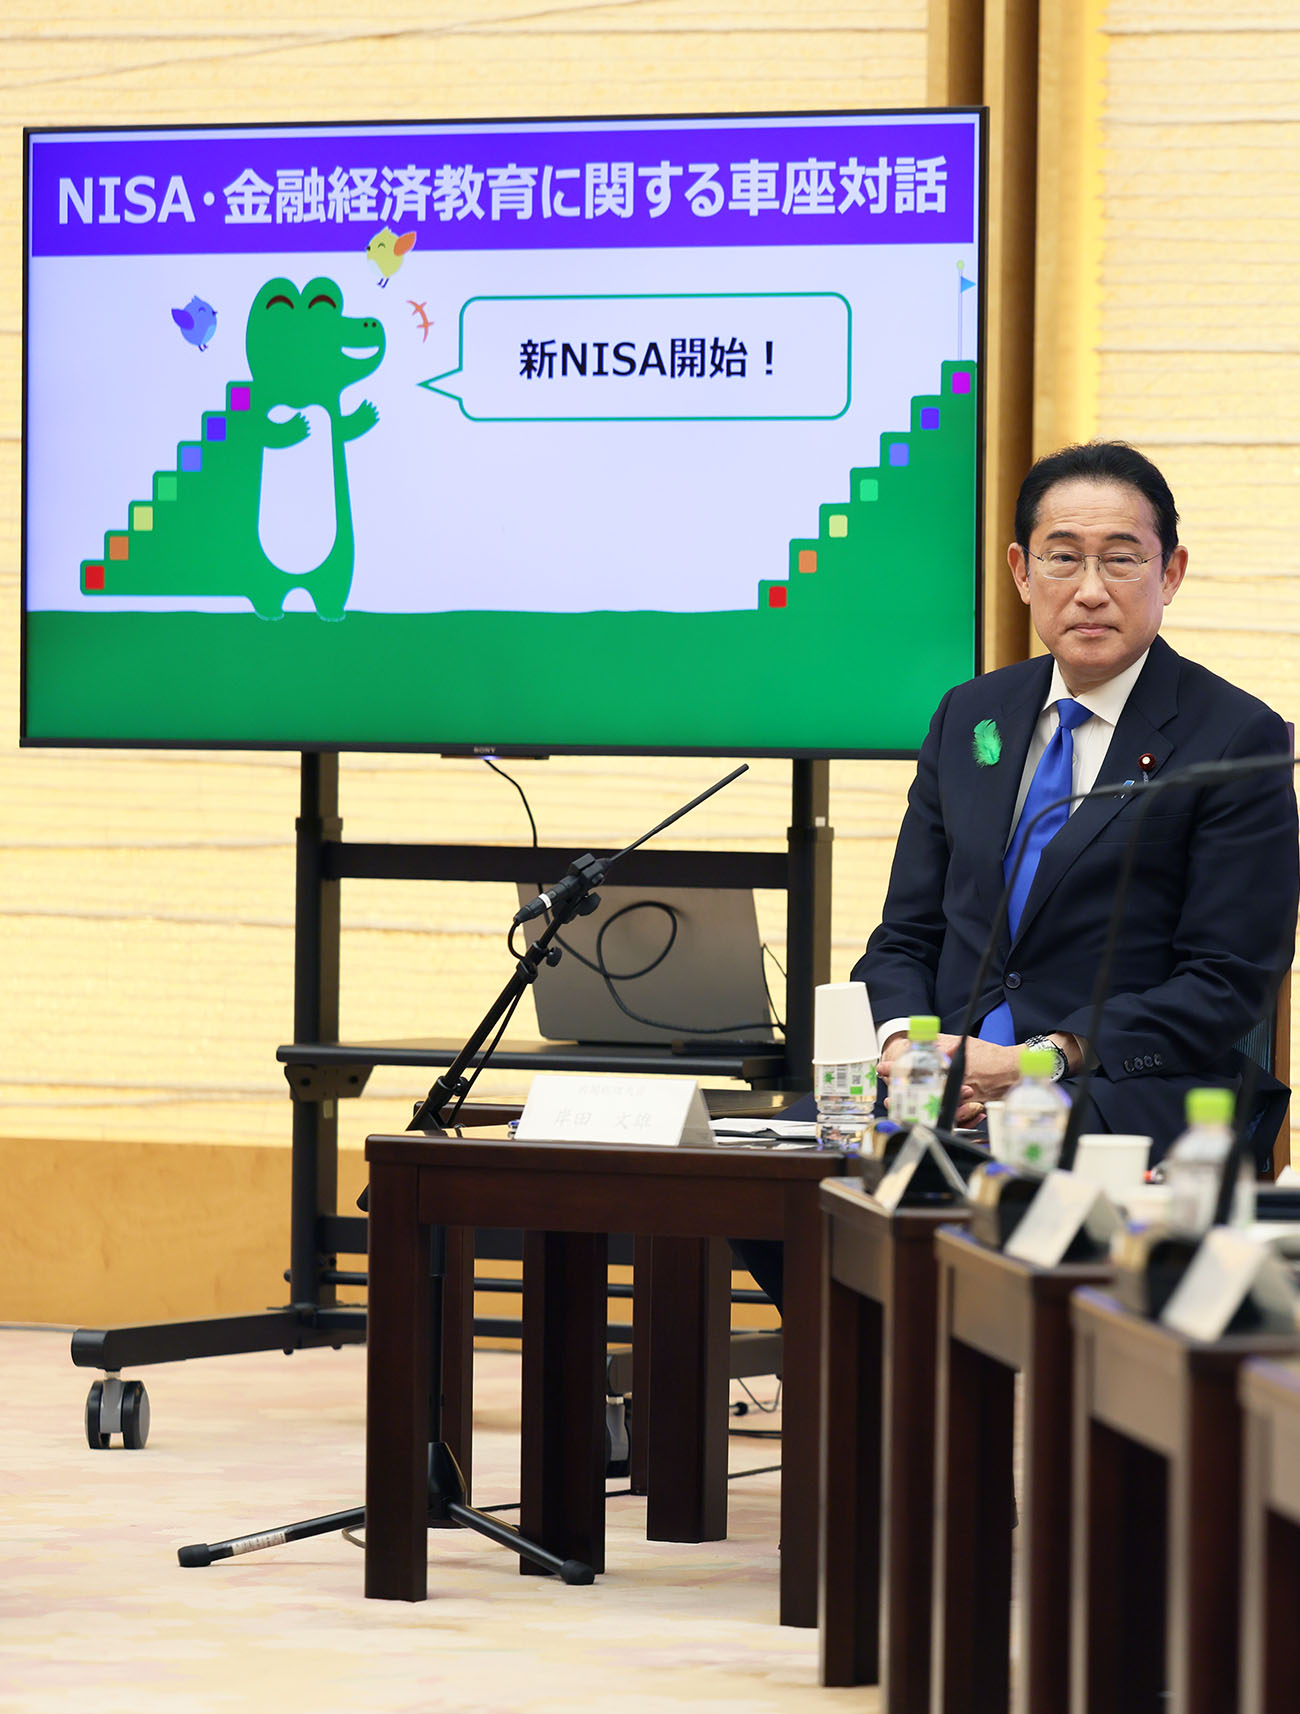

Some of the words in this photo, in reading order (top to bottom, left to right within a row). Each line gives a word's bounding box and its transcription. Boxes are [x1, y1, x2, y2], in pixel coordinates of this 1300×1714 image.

[58, 156, 948, 226] NISA・金融経済教育に関する車座対話
[519, 337, 776, 381] 新NISA開始！
